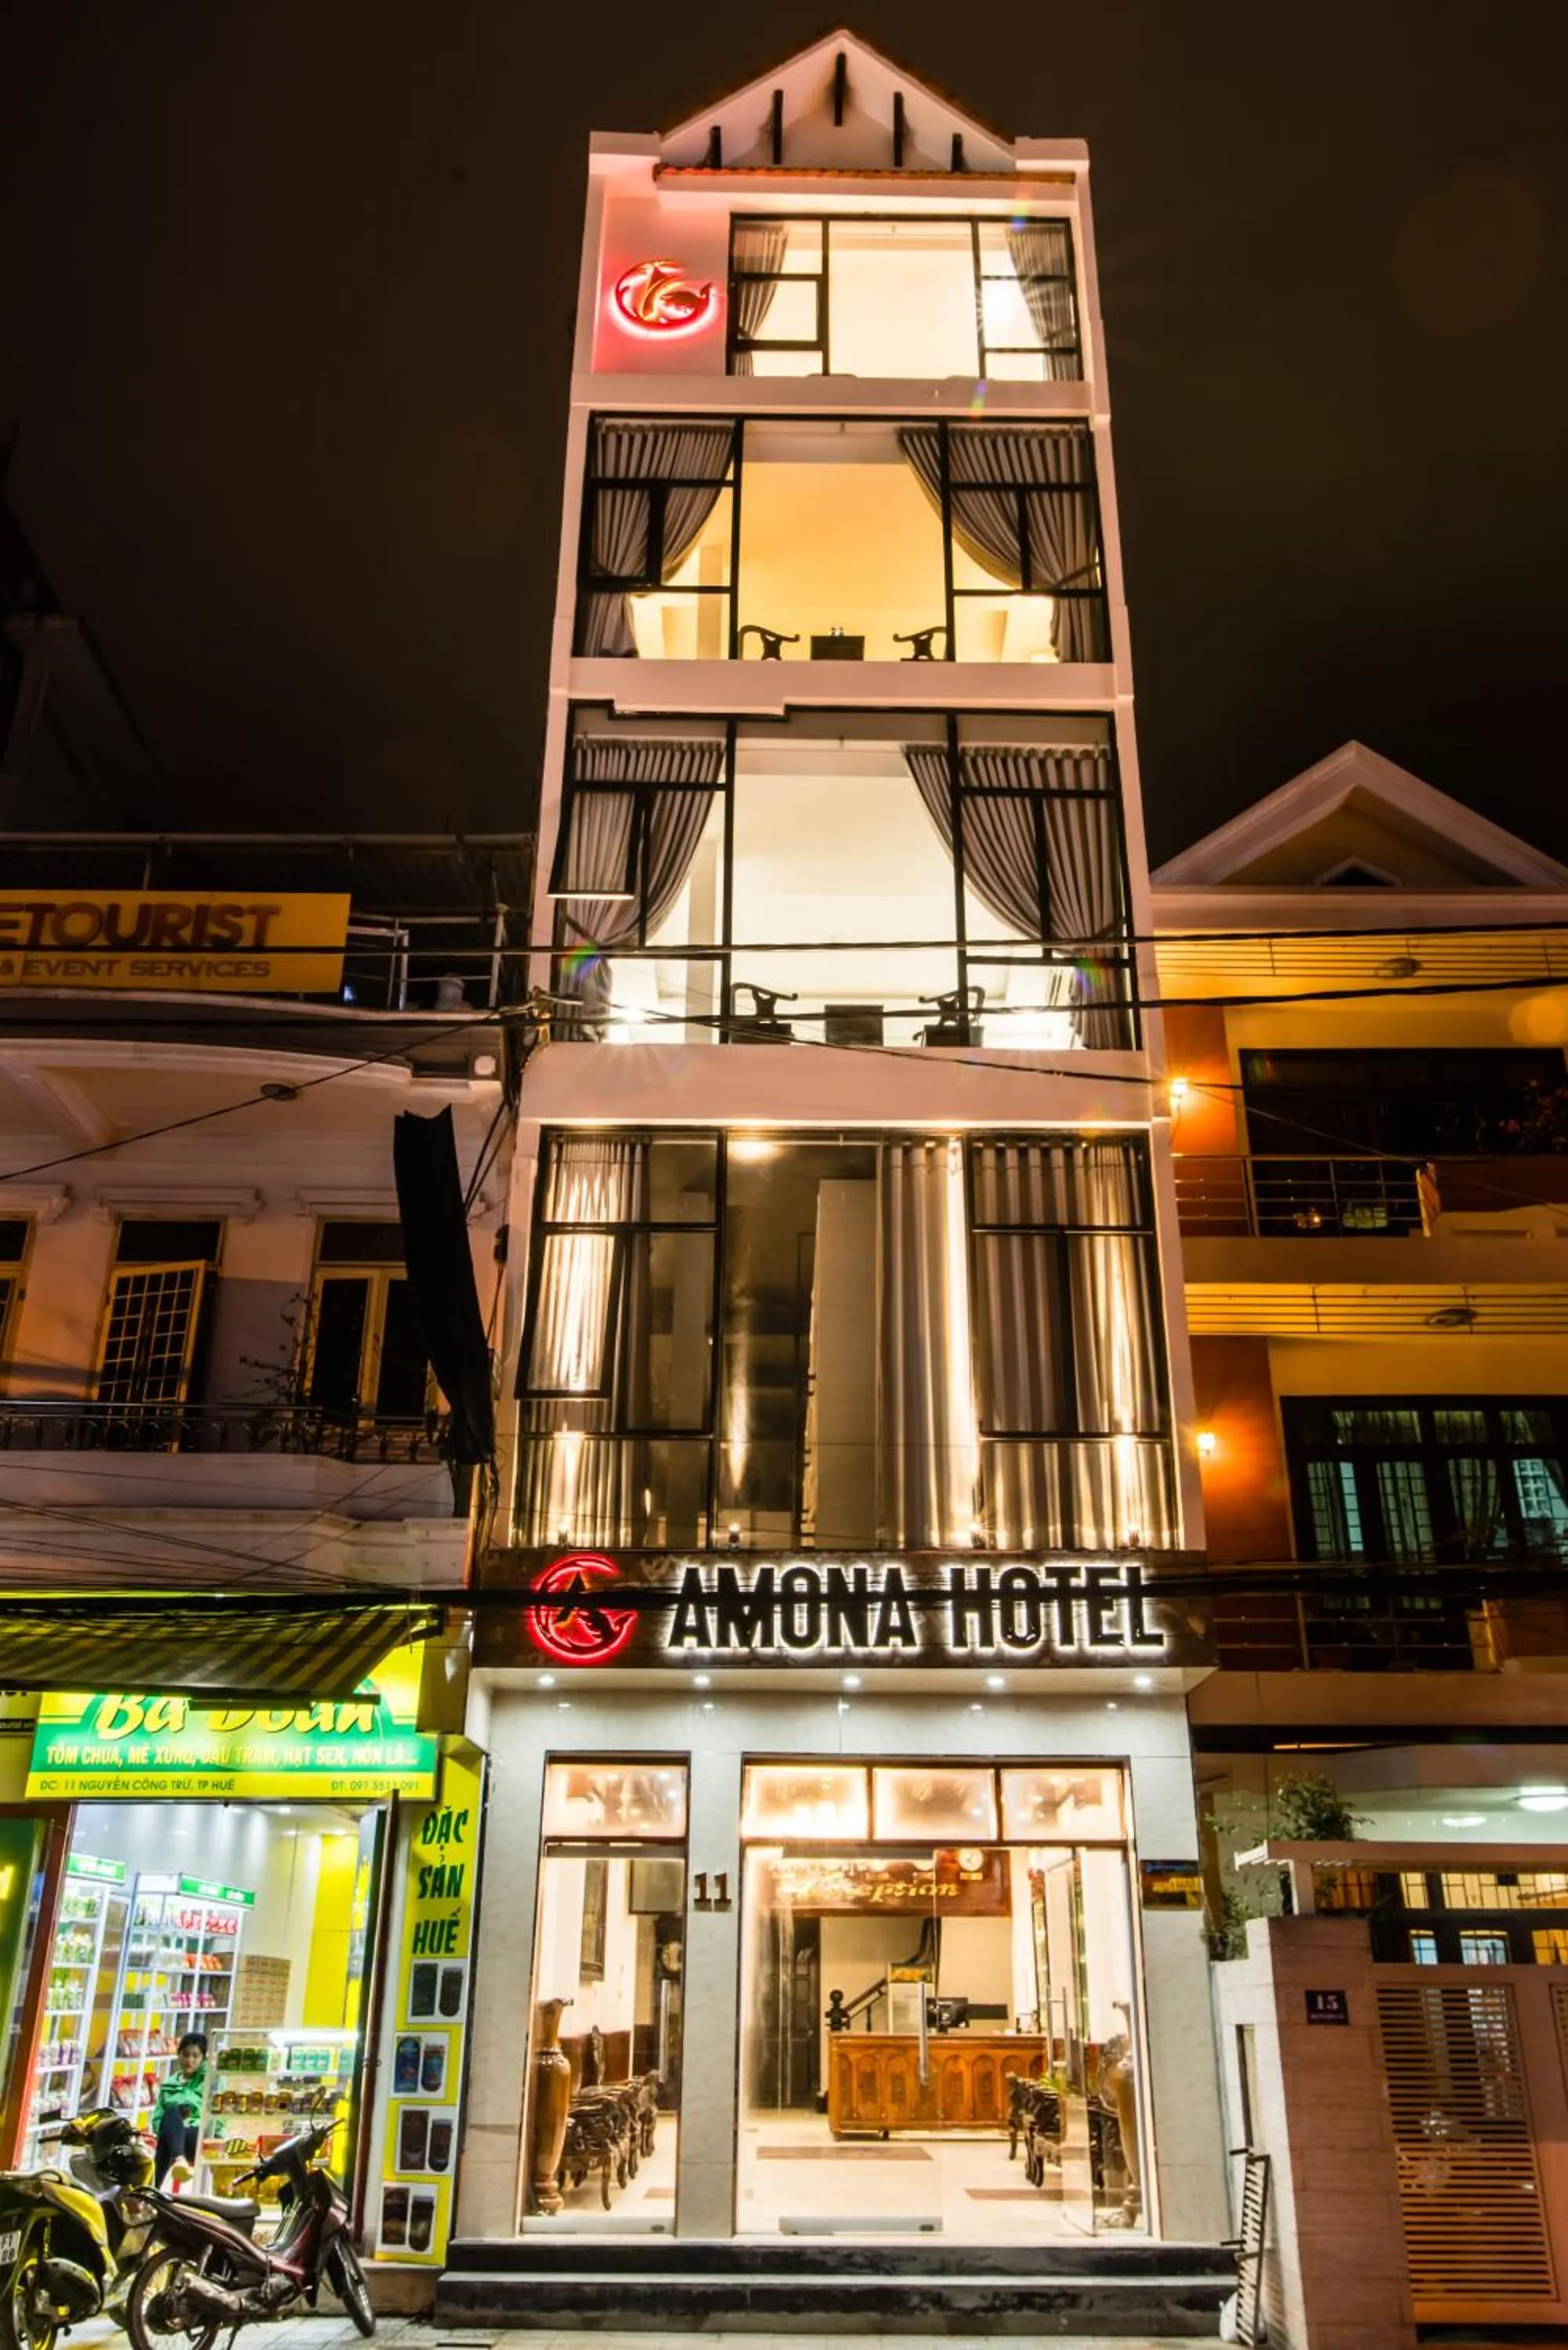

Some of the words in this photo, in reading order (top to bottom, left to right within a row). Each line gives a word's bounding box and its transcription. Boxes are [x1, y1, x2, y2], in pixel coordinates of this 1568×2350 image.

[23, 960, 121, 976] EVENT
[128, 960, 271, 977] SERVICES
[667, 1567, 919, 1649] AMONA
[950, 1567, 1165, 1648] HOTEL
[421, 1805, 469, 1851] ĐẶC
[417, 1855, 464, 1900] SẢN
[693, 1872, 732, 1908] 11
[413, 1907, 461, 1955] HUẾ
